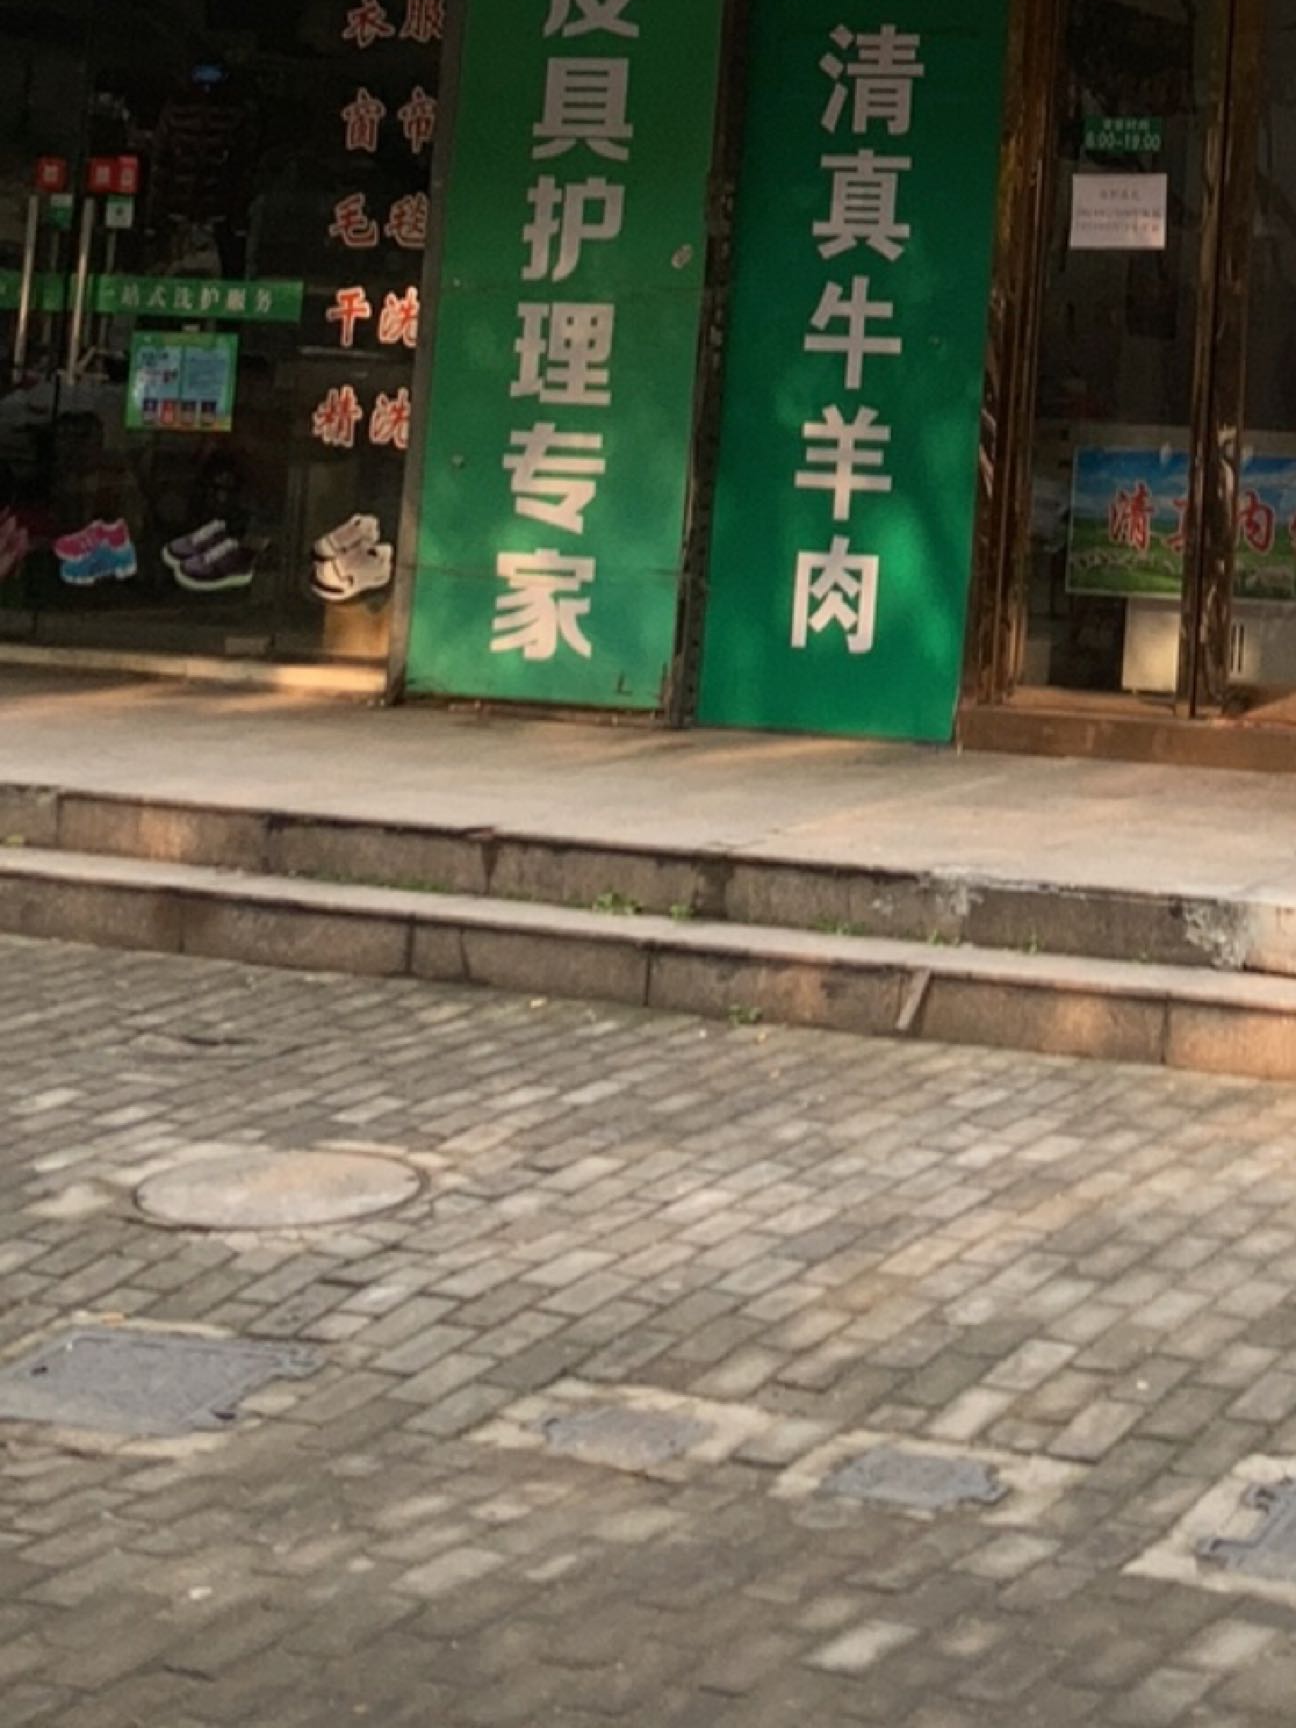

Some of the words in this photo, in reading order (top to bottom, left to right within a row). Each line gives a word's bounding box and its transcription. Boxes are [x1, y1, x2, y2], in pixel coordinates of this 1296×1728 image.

[325, 285, 421, 349] 干洗
[790, 23, 925, 656] 清真牛羊肉
